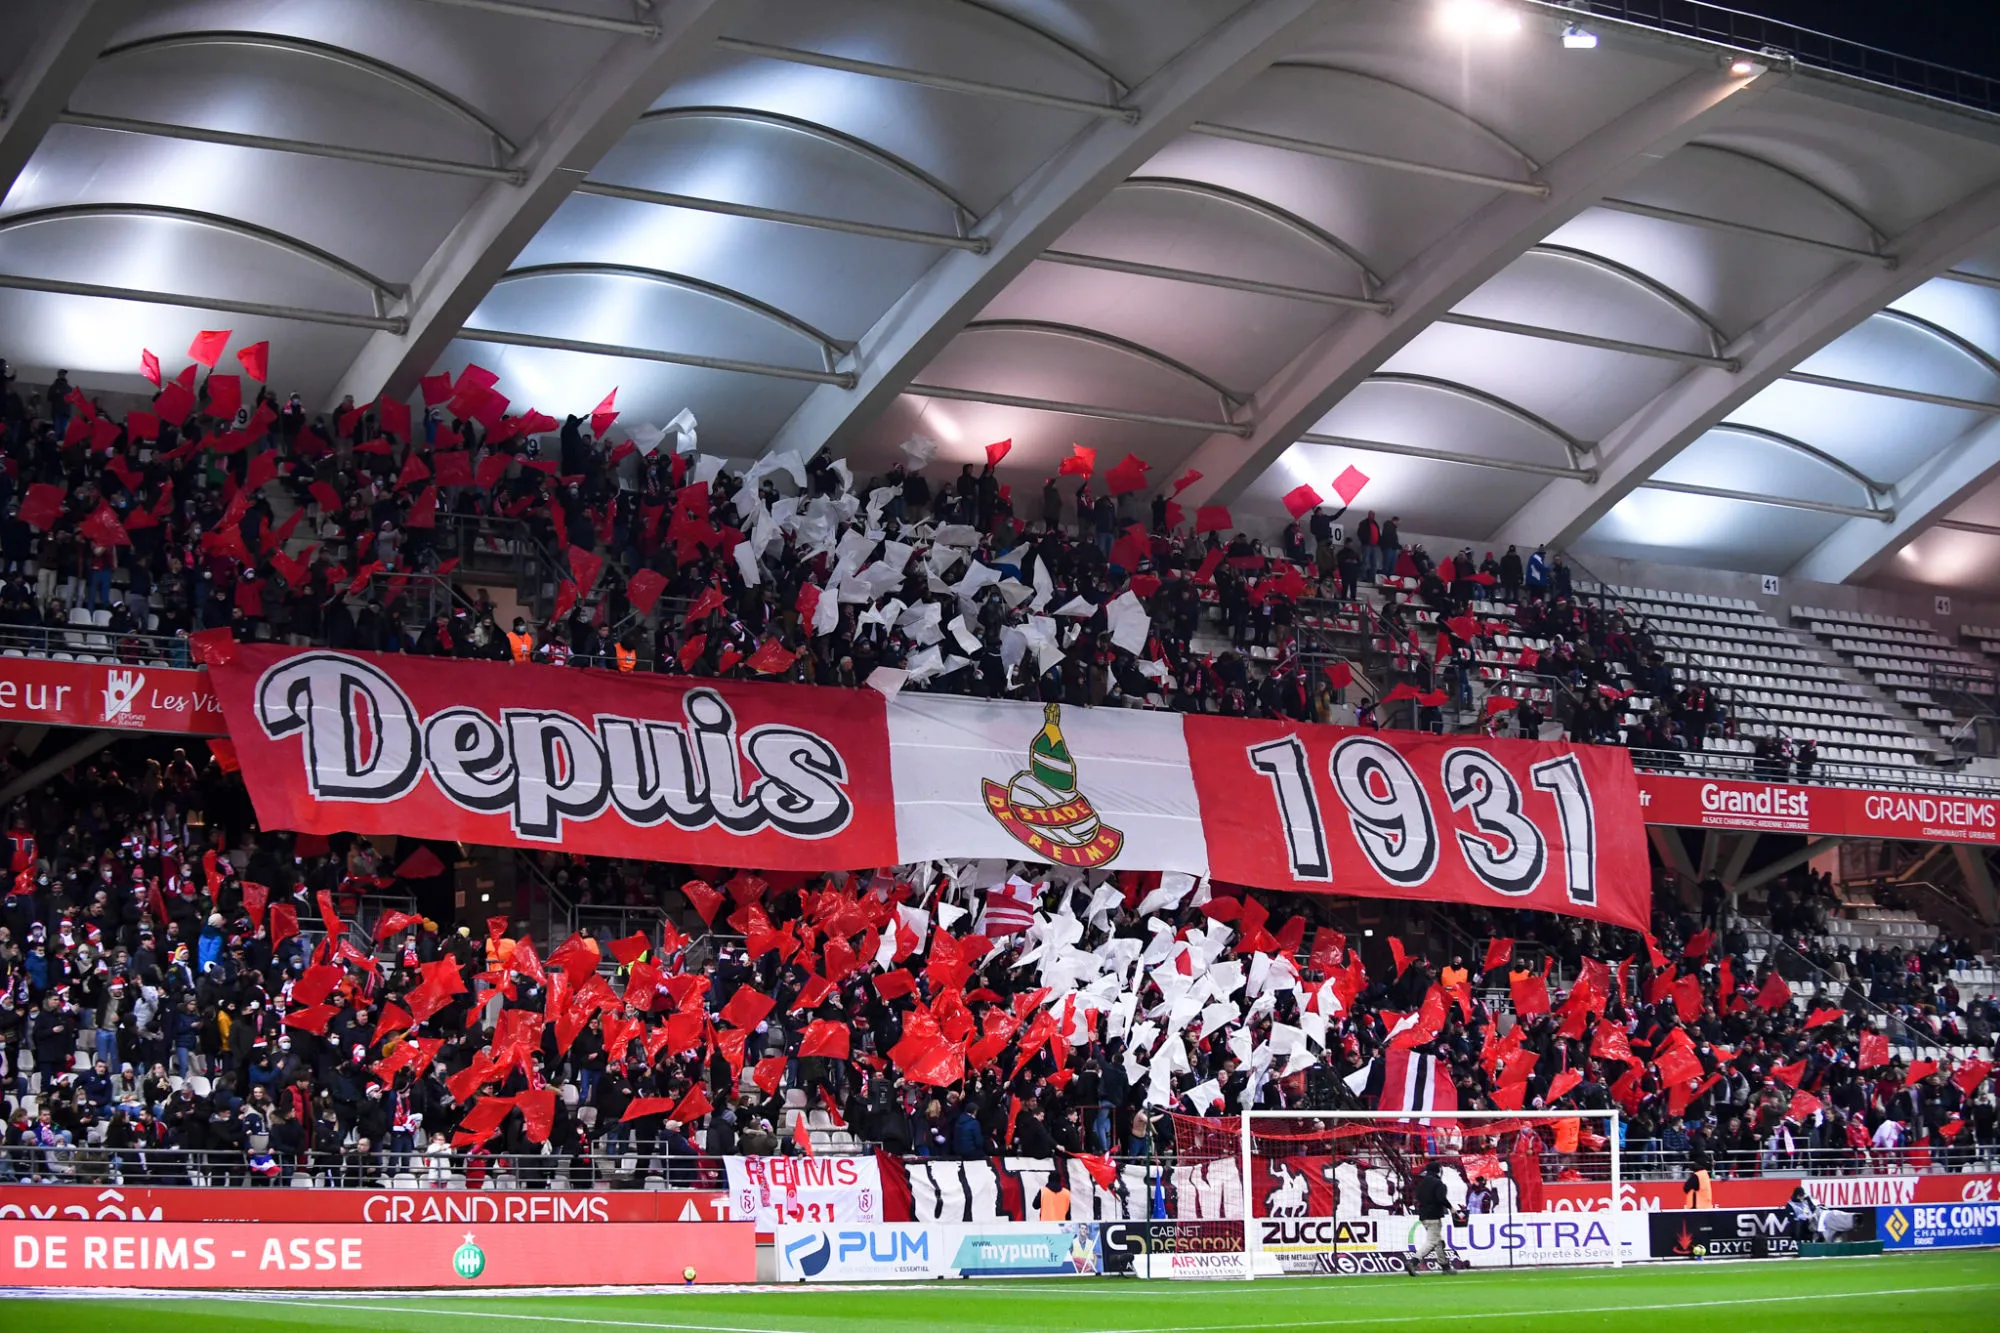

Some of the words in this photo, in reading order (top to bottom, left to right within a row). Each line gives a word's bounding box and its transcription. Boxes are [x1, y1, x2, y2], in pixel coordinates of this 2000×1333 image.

[1763, 579, 1777, 592] 41
[151, 688, 190, 712] Les
[254, 650, 855, 843] Depuis
[1246, 733, 1598, 907] 1931
[1019, 802, 1090, 823] STADE
[1865, 795, 1937, 823] GRAND
[1939, 801, 1997, 828] REIMS
[988, 795, 1013, 821] DE
[1028, 834, 1116, 864] REIMS
[1811, 1181, 1904, 1206] WINAMAX
[1913, 1207, 1948, 1230] BEC
[1149, 1225, 1200, 1238] CABINET
[1261, 1220, 1378, 1244] ZUCCARI
[1913, 1228, 1983, 1237] CHAMPAGNE
[14, 1235, 68, 1269] DE
[84, 1236, 216, 1271] REIMS
[260, 1238, 363, 1271] ASSE
[838, 1230, 929, 1263] PUM
[1584, 1247, 1633, 1258] Servies
[1171, 1255, 1243, 1268] AIRWORK
